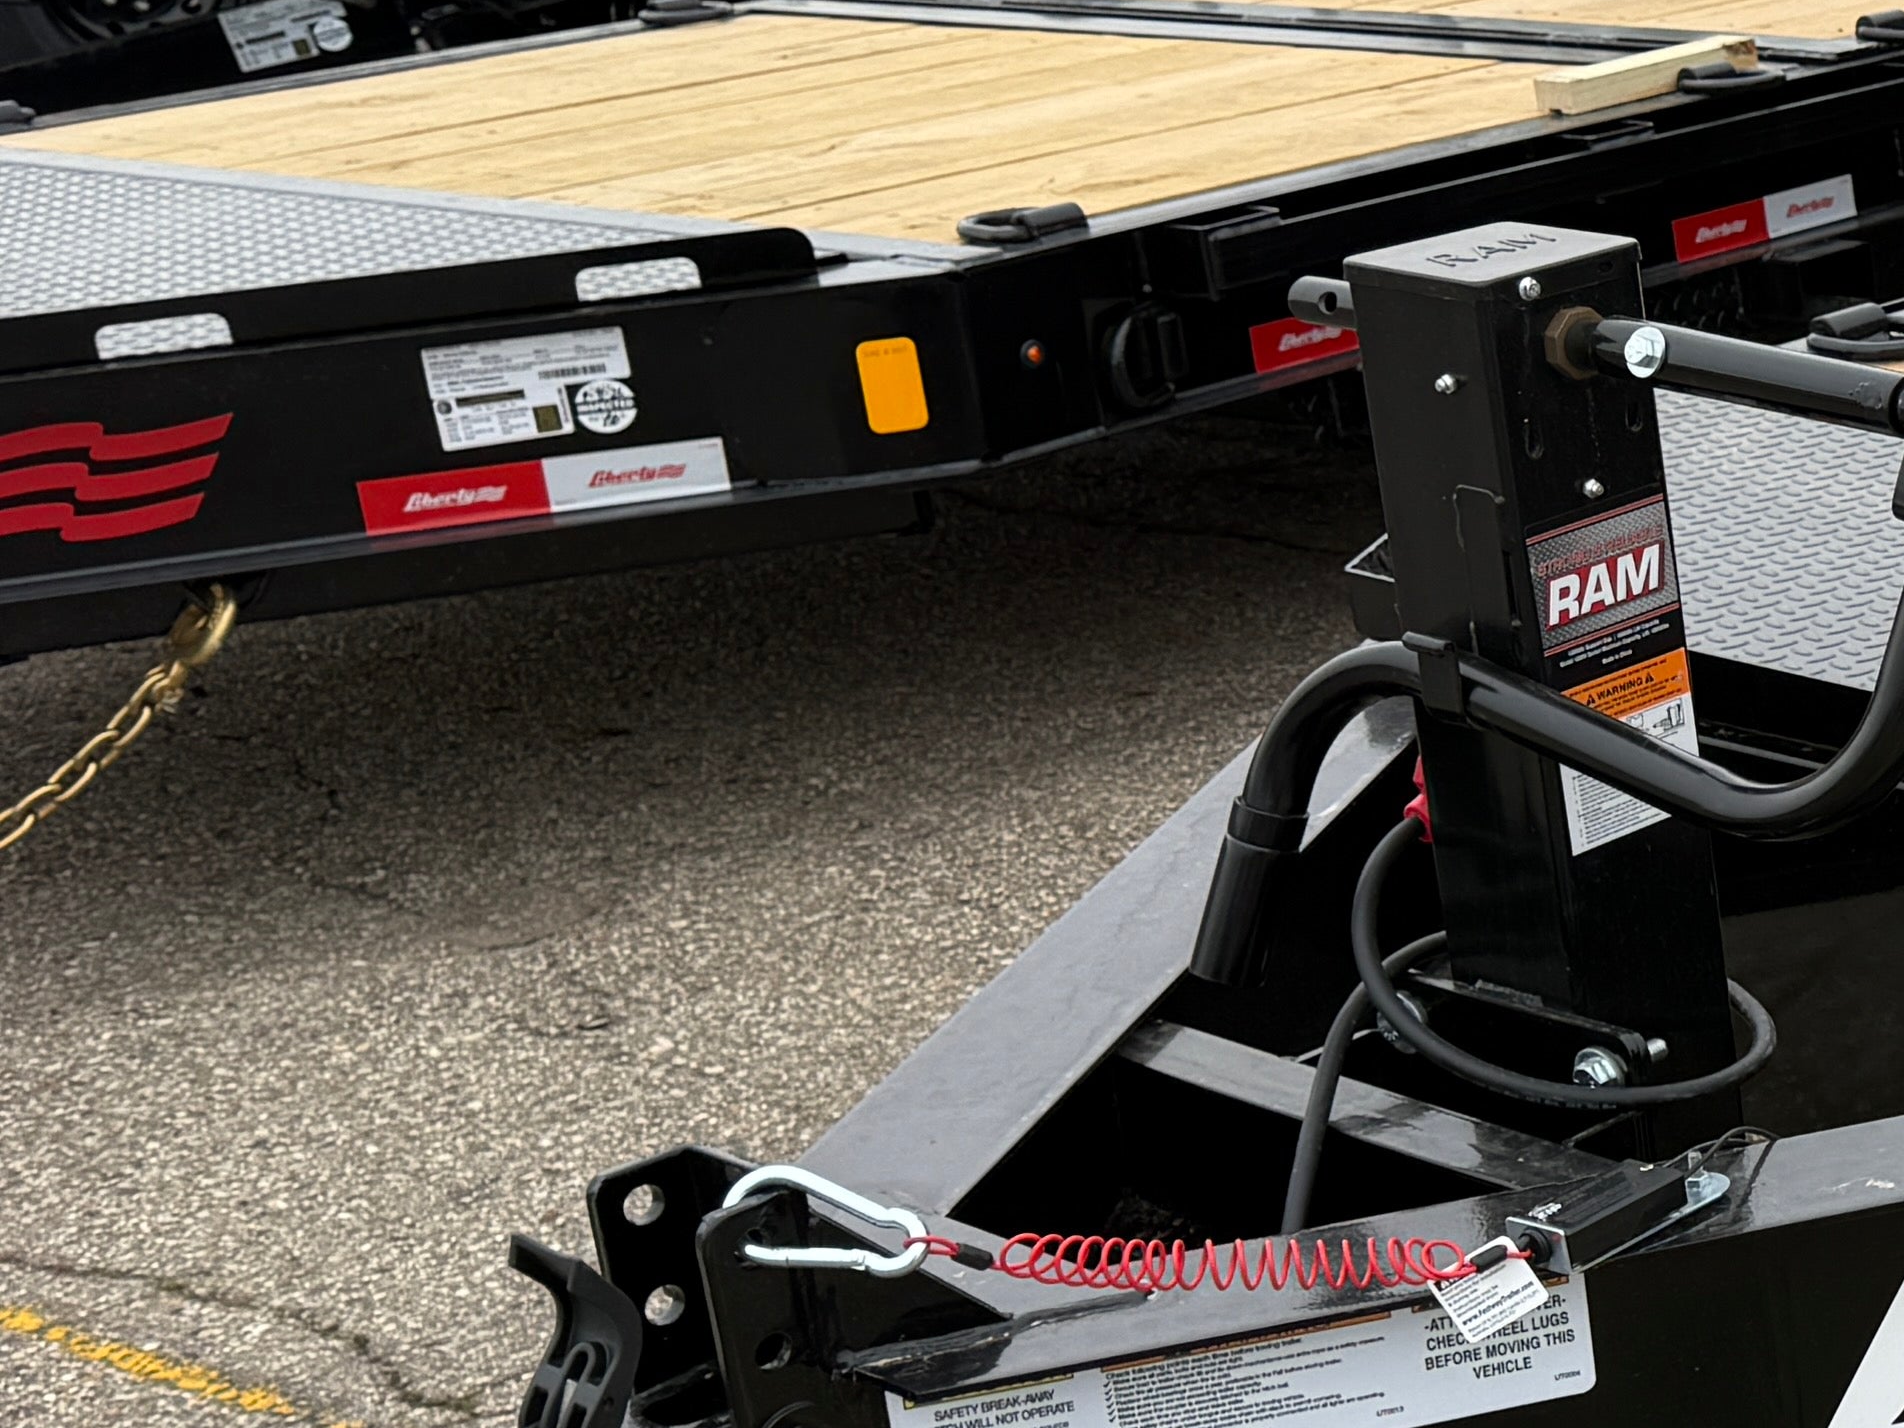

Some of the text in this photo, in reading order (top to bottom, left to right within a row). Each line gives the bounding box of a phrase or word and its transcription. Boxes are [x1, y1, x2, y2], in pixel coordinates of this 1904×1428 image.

[1426, 233, 1557, 267] RAM
[1548, 543, 1660, 627] RAM
[1596, 677, 1643, 701] WARNING
[1427, 1329, 1471, 1351] CHEC
[1532, 1311, 1569, 1328] LUGS
[1424, 1329, 1575, 1371] BEFORE MOVING THIS
[1473, 1356, 1532, 1379] VEHICLE
[933, 1389, 1055, 1423] SAFETY BREAK-AWAY
[995, 1411, 1020, 1426] NOT
[1021, 1400, 1075, 1420] OPERATE
